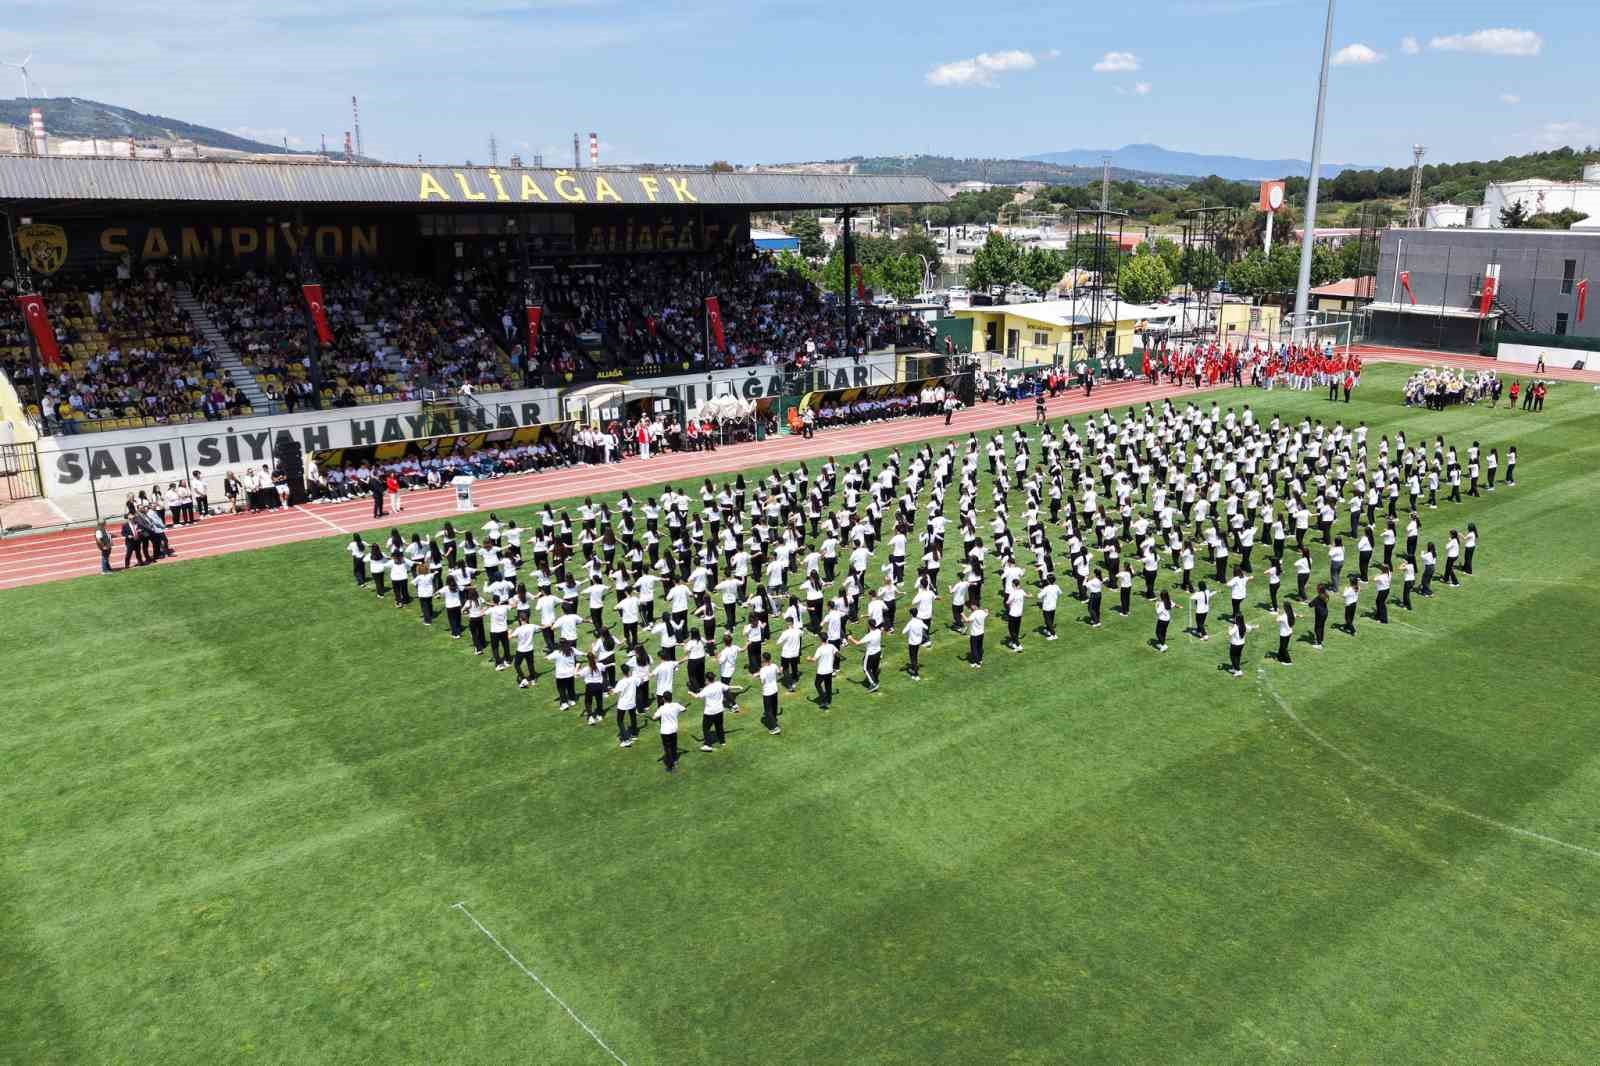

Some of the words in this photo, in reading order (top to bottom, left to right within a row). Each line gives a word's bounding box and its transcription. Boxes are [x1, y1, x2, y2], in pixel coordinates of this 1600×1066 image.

[419, 168, 622, 203] ALİAĞA
[638, 175, 697, 202] FK
[56, 442, 174, 484] SARI
[197, 426, 330, 467] SİYAH
